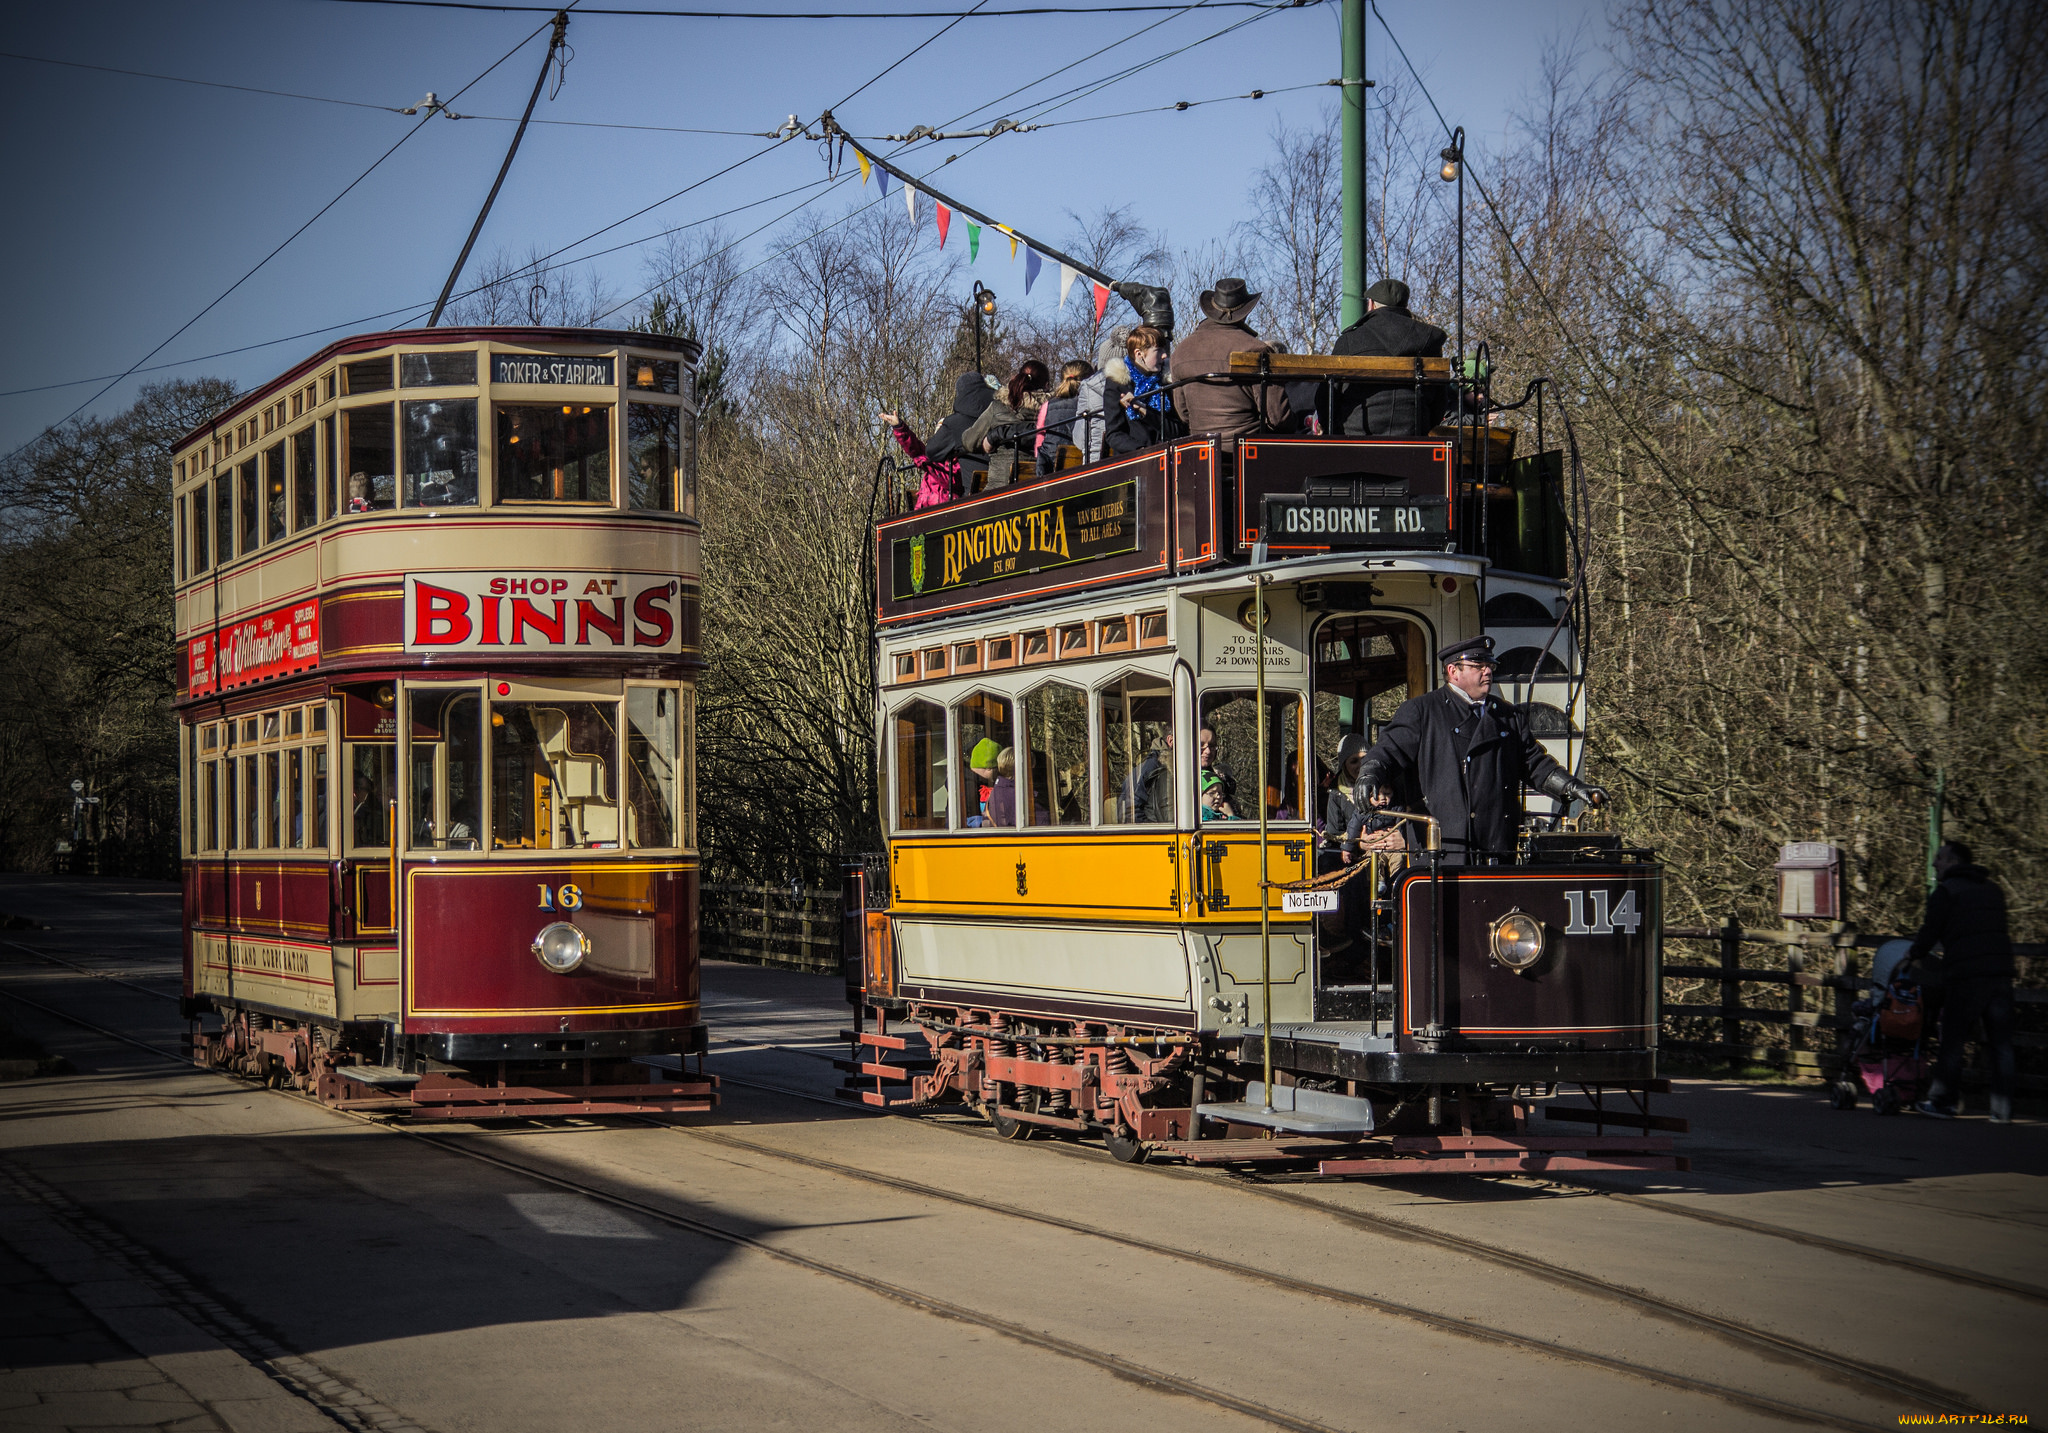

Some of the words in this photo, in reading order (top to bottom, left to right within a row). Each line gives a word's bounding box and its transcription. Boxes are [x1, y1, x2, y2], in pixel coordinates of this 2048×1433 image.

[500, 362, 541, 384] ROKER
[542, 368, 550, 380] &
[550, 363, 606, 385] SEABURN
[1077, 510, 1090, 526] VAN
[1091, 500, 1124, 522] DELIVERIES
[1286, 507, 1380, 533] OSBORNE
[1395, 507, 1426, 533] RD.
[1081, 528, 1089, 543] TO
[1089, 526, 1100, 542] ALL
[1102, 521, 1122, 539] AREAS
[942, 516, 1022, 587] RINGTONS
[1025, 505, 1071, 559] TEA
[490, 578, 568, 595] SHOP
[583, 579, 618, 595] AT
[234, 623, 283, 673] Williamson
[1223, 646, 1235, 655] 29
[1239, 646, 1284, 655] UPSAIRS
[1232, 635, 1246, 644] TO
[1215, 657, 1227, 665] 24
[1231, 657, 1290, 666] DOWNTAIRS
[538, 884, 582, 911] 16
[1289, 894, 1302, 908] No
[1303, 894, 1328, 909] Entry
[1564, 889, 1641, 935] 114
[217, 943, 257, 966] SUNERLAND
